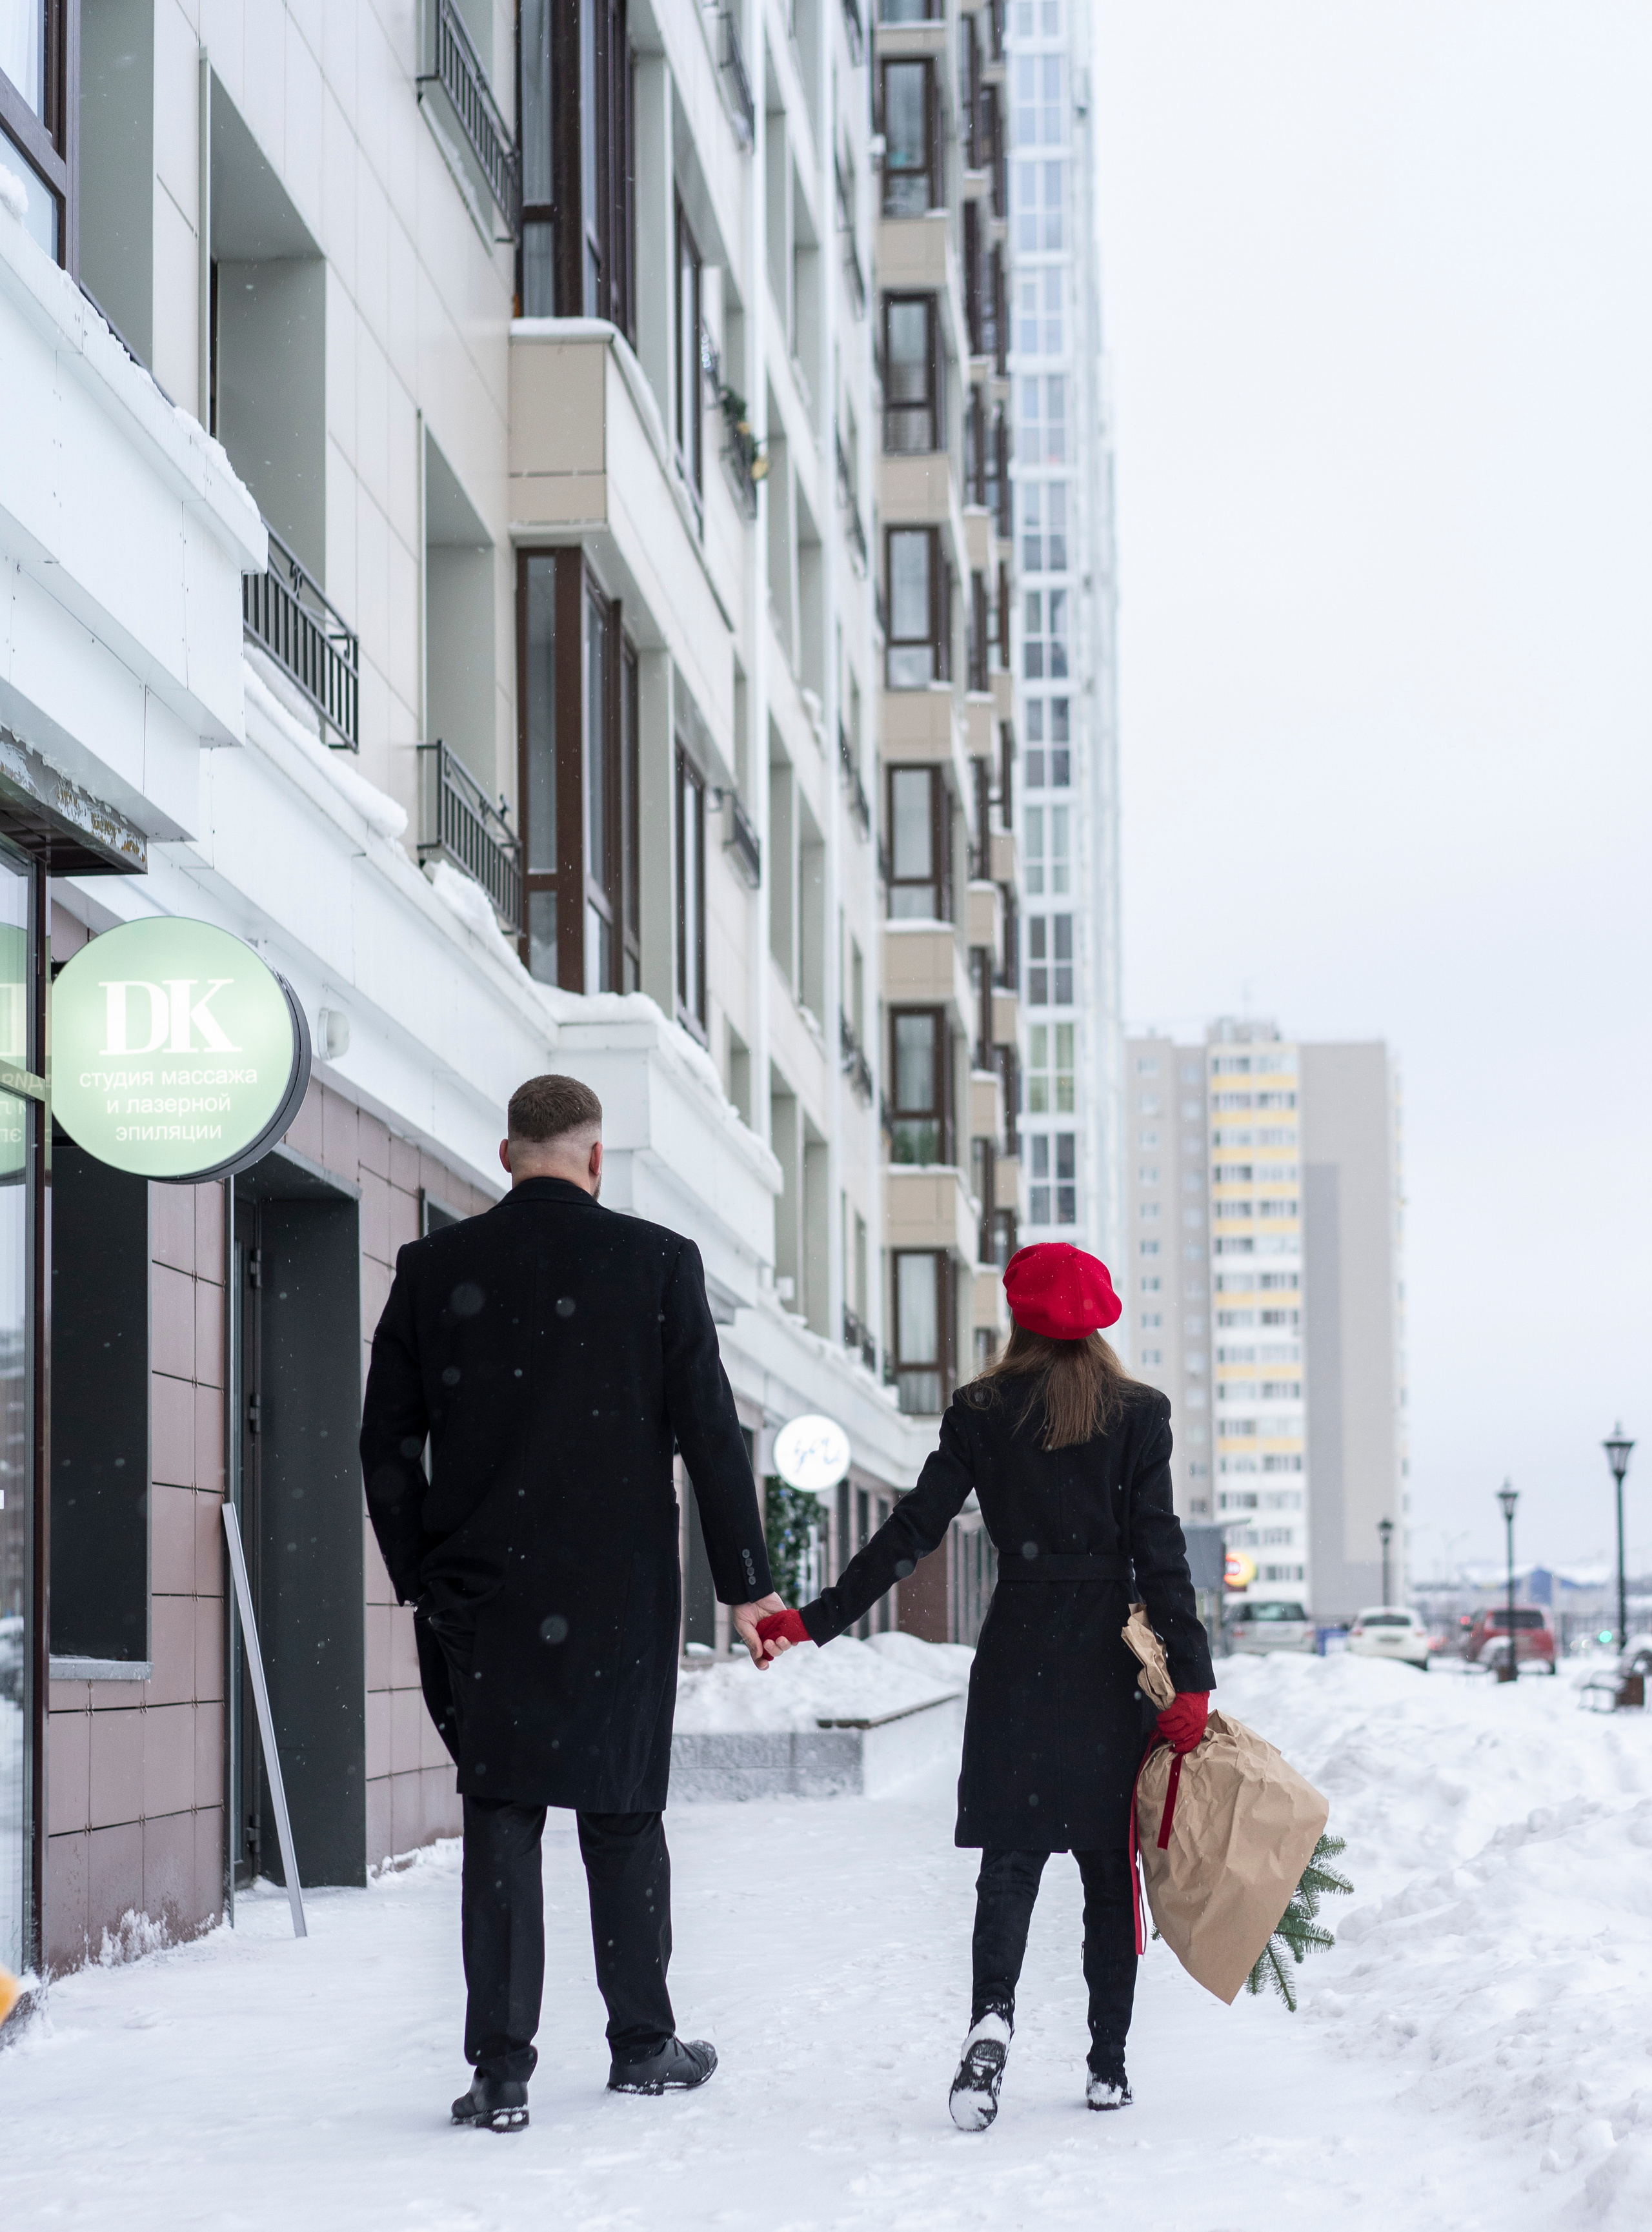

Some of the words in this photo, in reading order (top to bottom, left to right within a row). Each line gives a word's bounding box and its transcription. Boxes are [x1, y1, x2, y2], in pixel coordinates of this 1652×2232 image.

[98, 979, 243, 1055] DK
[79, 1070, 154, 1092] студия
[161, 1068, 257, 1086] массажа
[107, 1101, 118, 1114] и
[126, 1093, 231, 1117] лазерной
[115, 1124, 222, 1143] эпиляции
